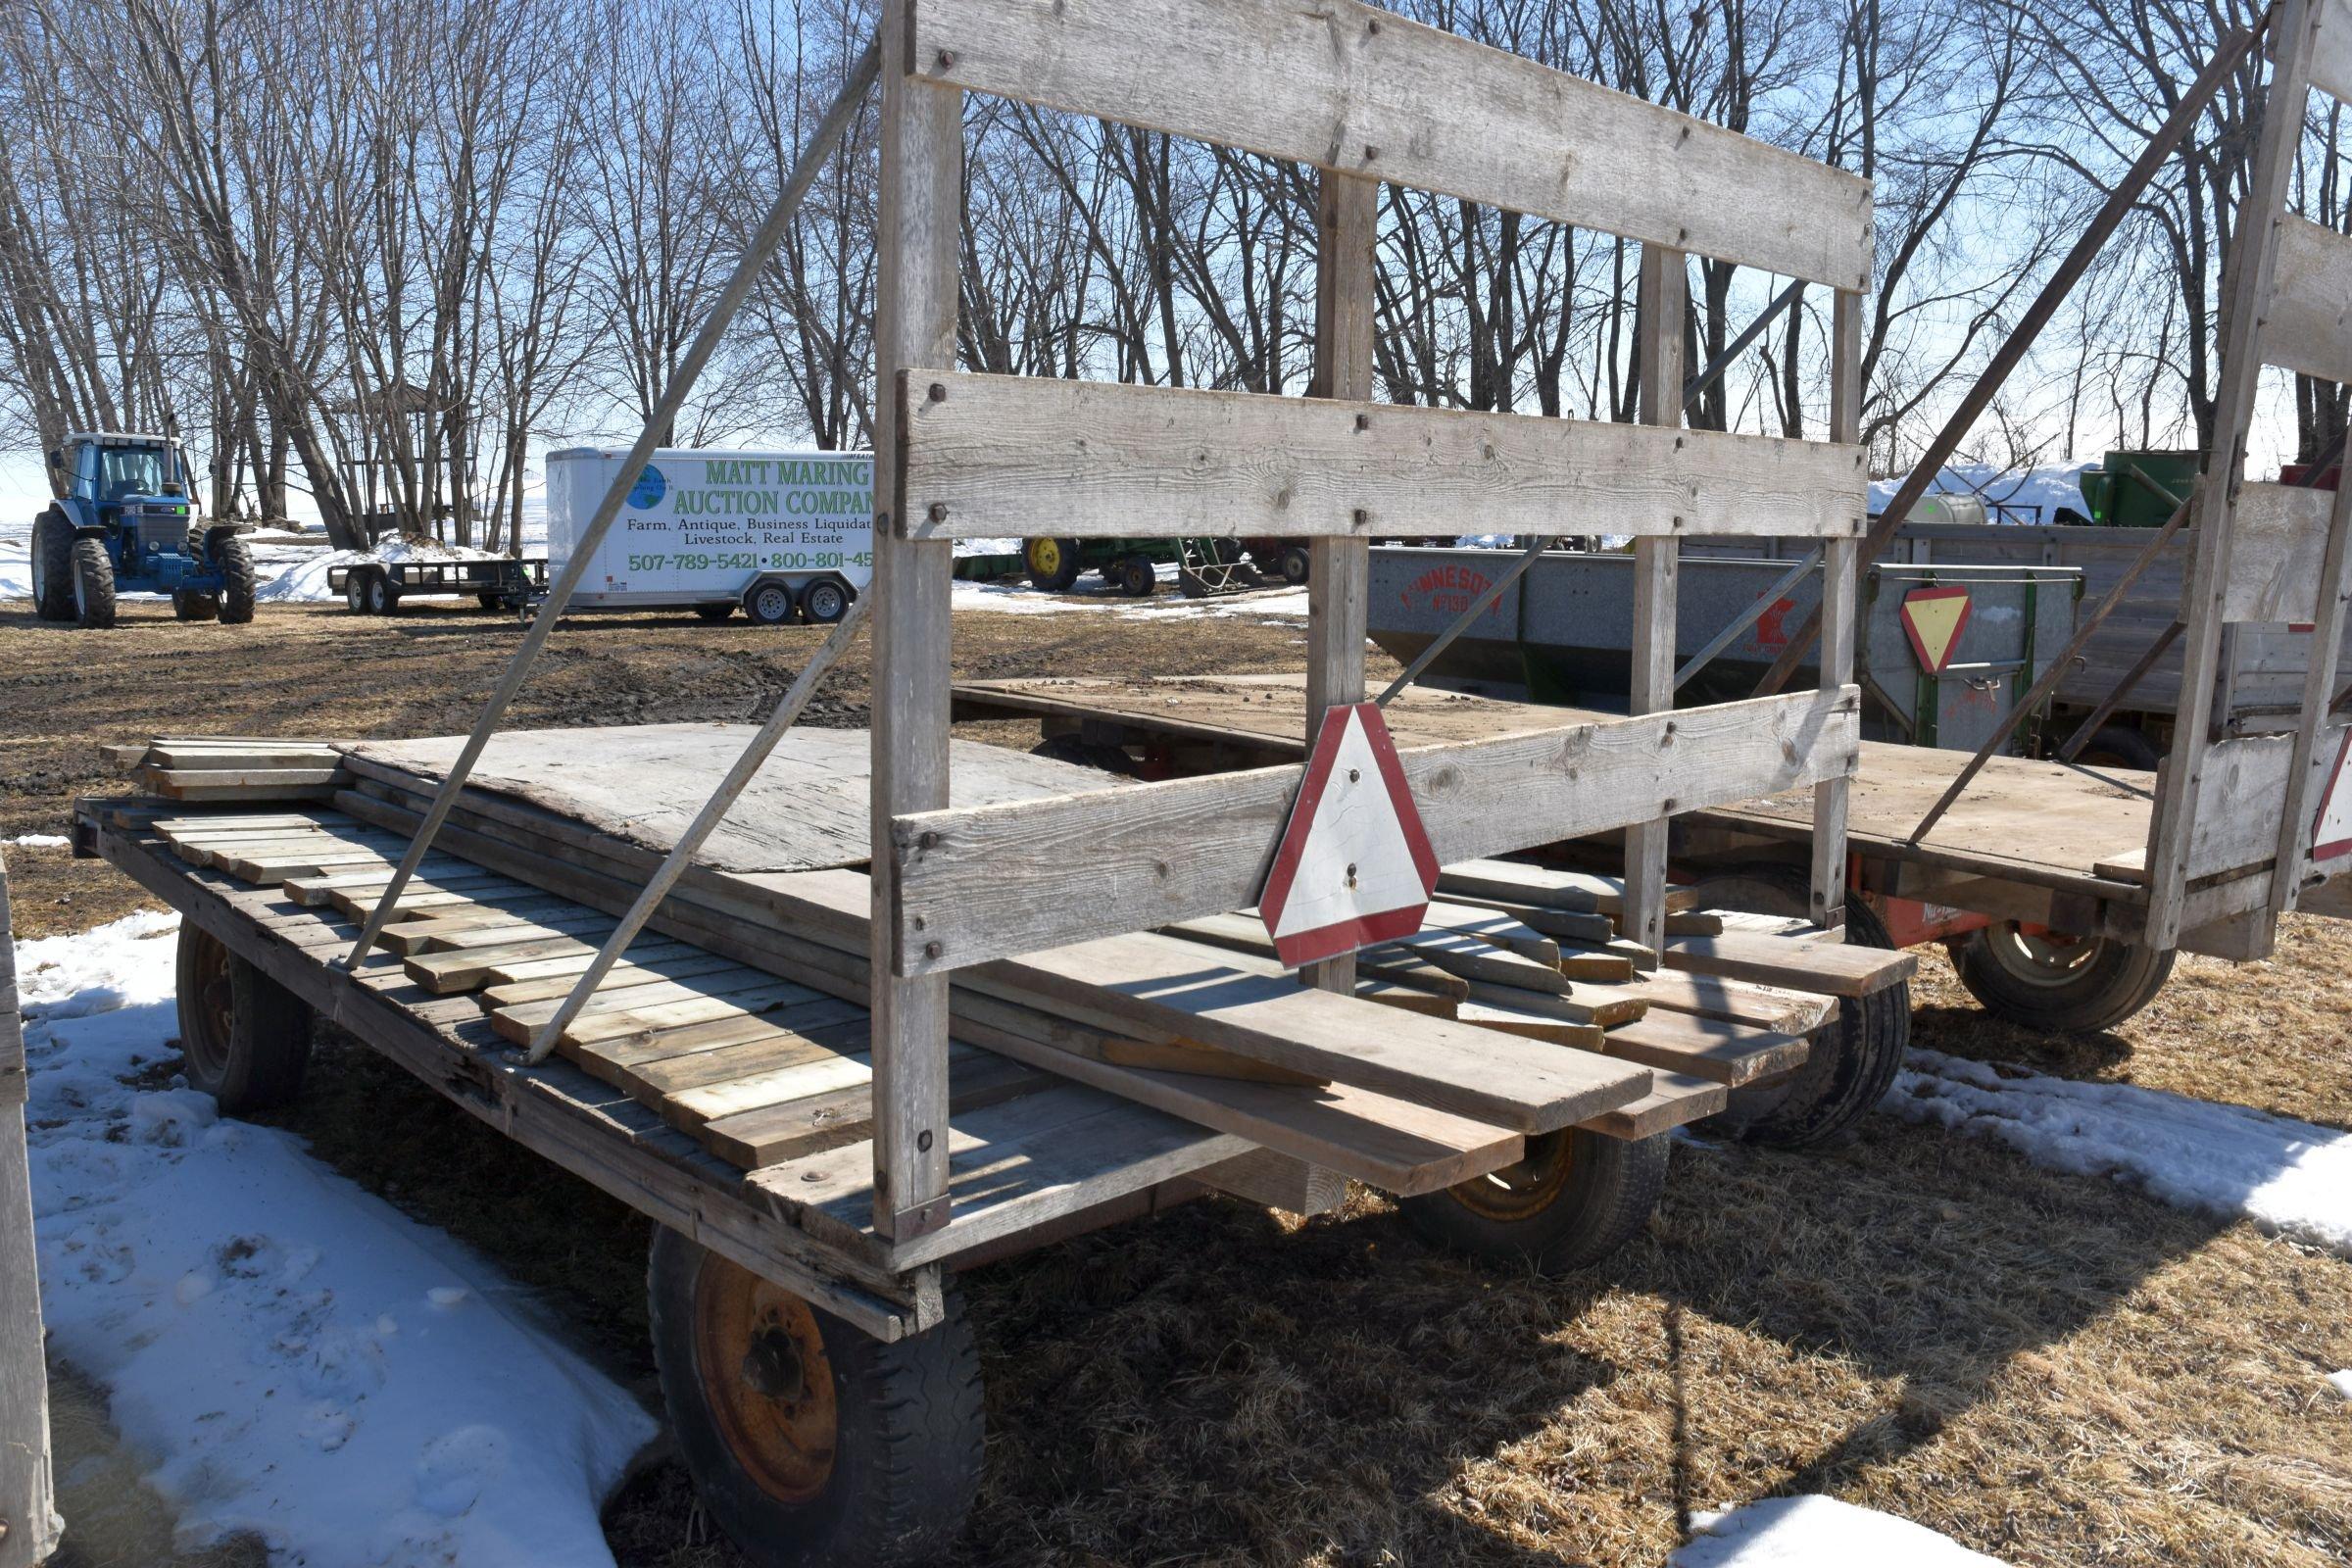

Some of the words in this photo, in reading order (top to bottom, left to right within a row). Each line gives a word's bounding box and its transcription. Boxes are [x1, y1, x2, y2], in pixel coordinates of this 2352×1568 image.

[706, 461, 771, 485] MATT
[777, 462, 869, 486] MARING
[673, 490, 779, 515] AUCTION
[627, 518, 671, 531] Farm,
[678, 518, 740, 533] Antique,
[748, 517, 808, 530] Business
[815, 517, 871, 532] Liquidat
[685, 532, 757, 545] Livestock,
[763, 532, 795, 544] Real
[802, 532, 844, 544] Estate
[628, 553, 759, 571] 507-789-5421
